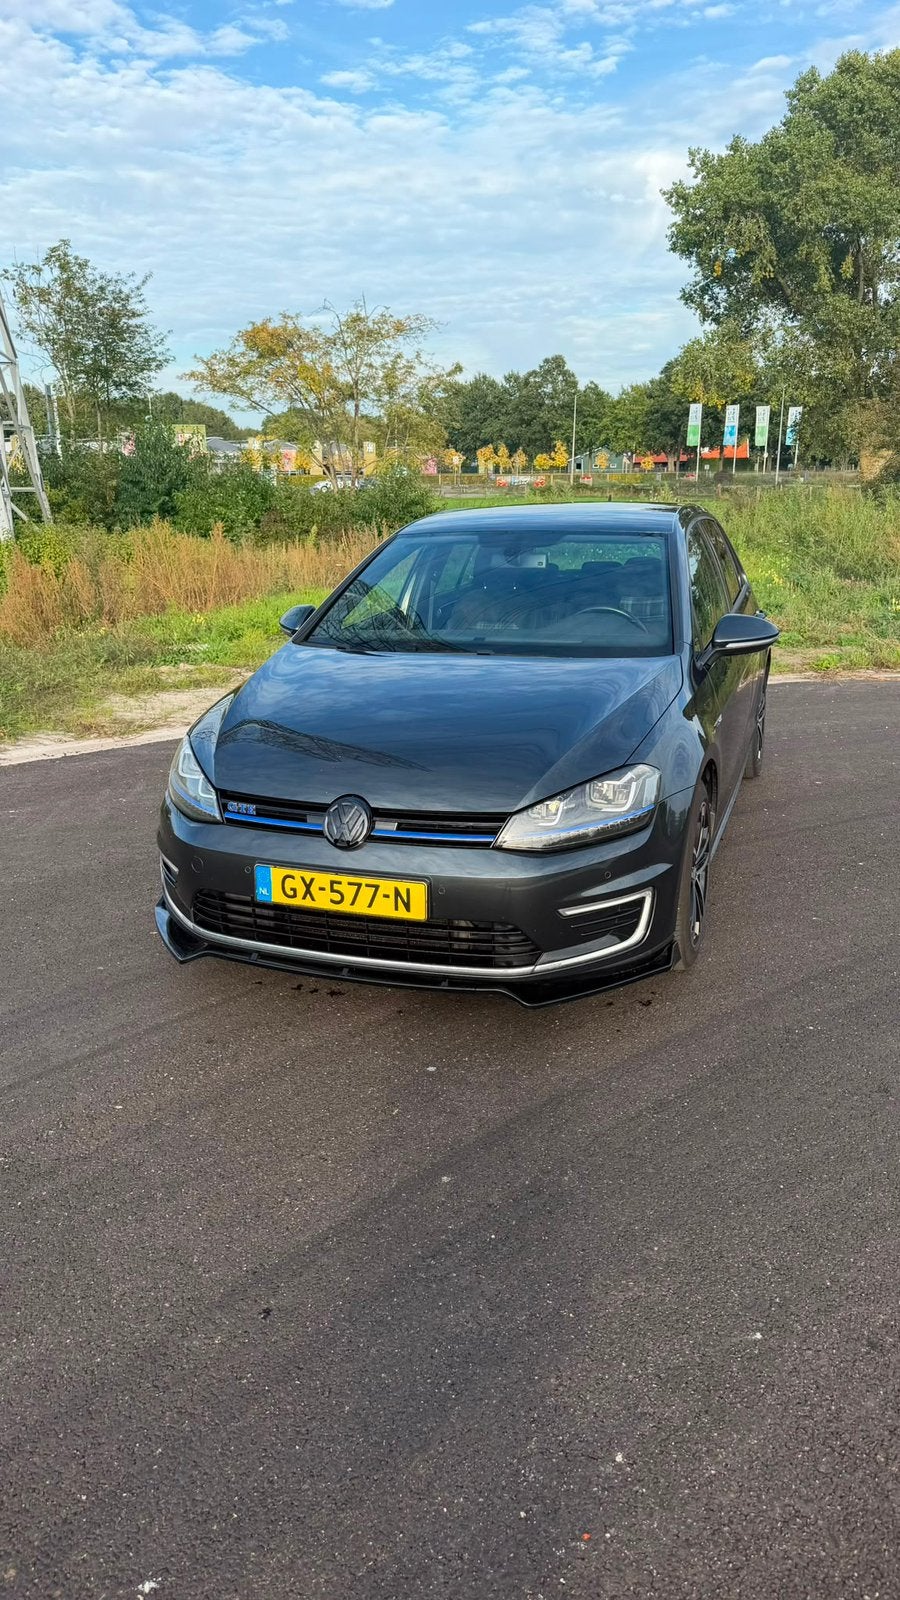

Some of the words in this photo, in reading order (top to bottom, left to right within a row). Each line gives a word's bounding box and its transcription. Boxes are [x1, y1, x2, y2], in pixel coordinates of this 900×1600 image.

[227, 801, 256, 815] GTE
[259, 888, 269, 896] NL
[281, 875, 411, 913] GX-577-N
